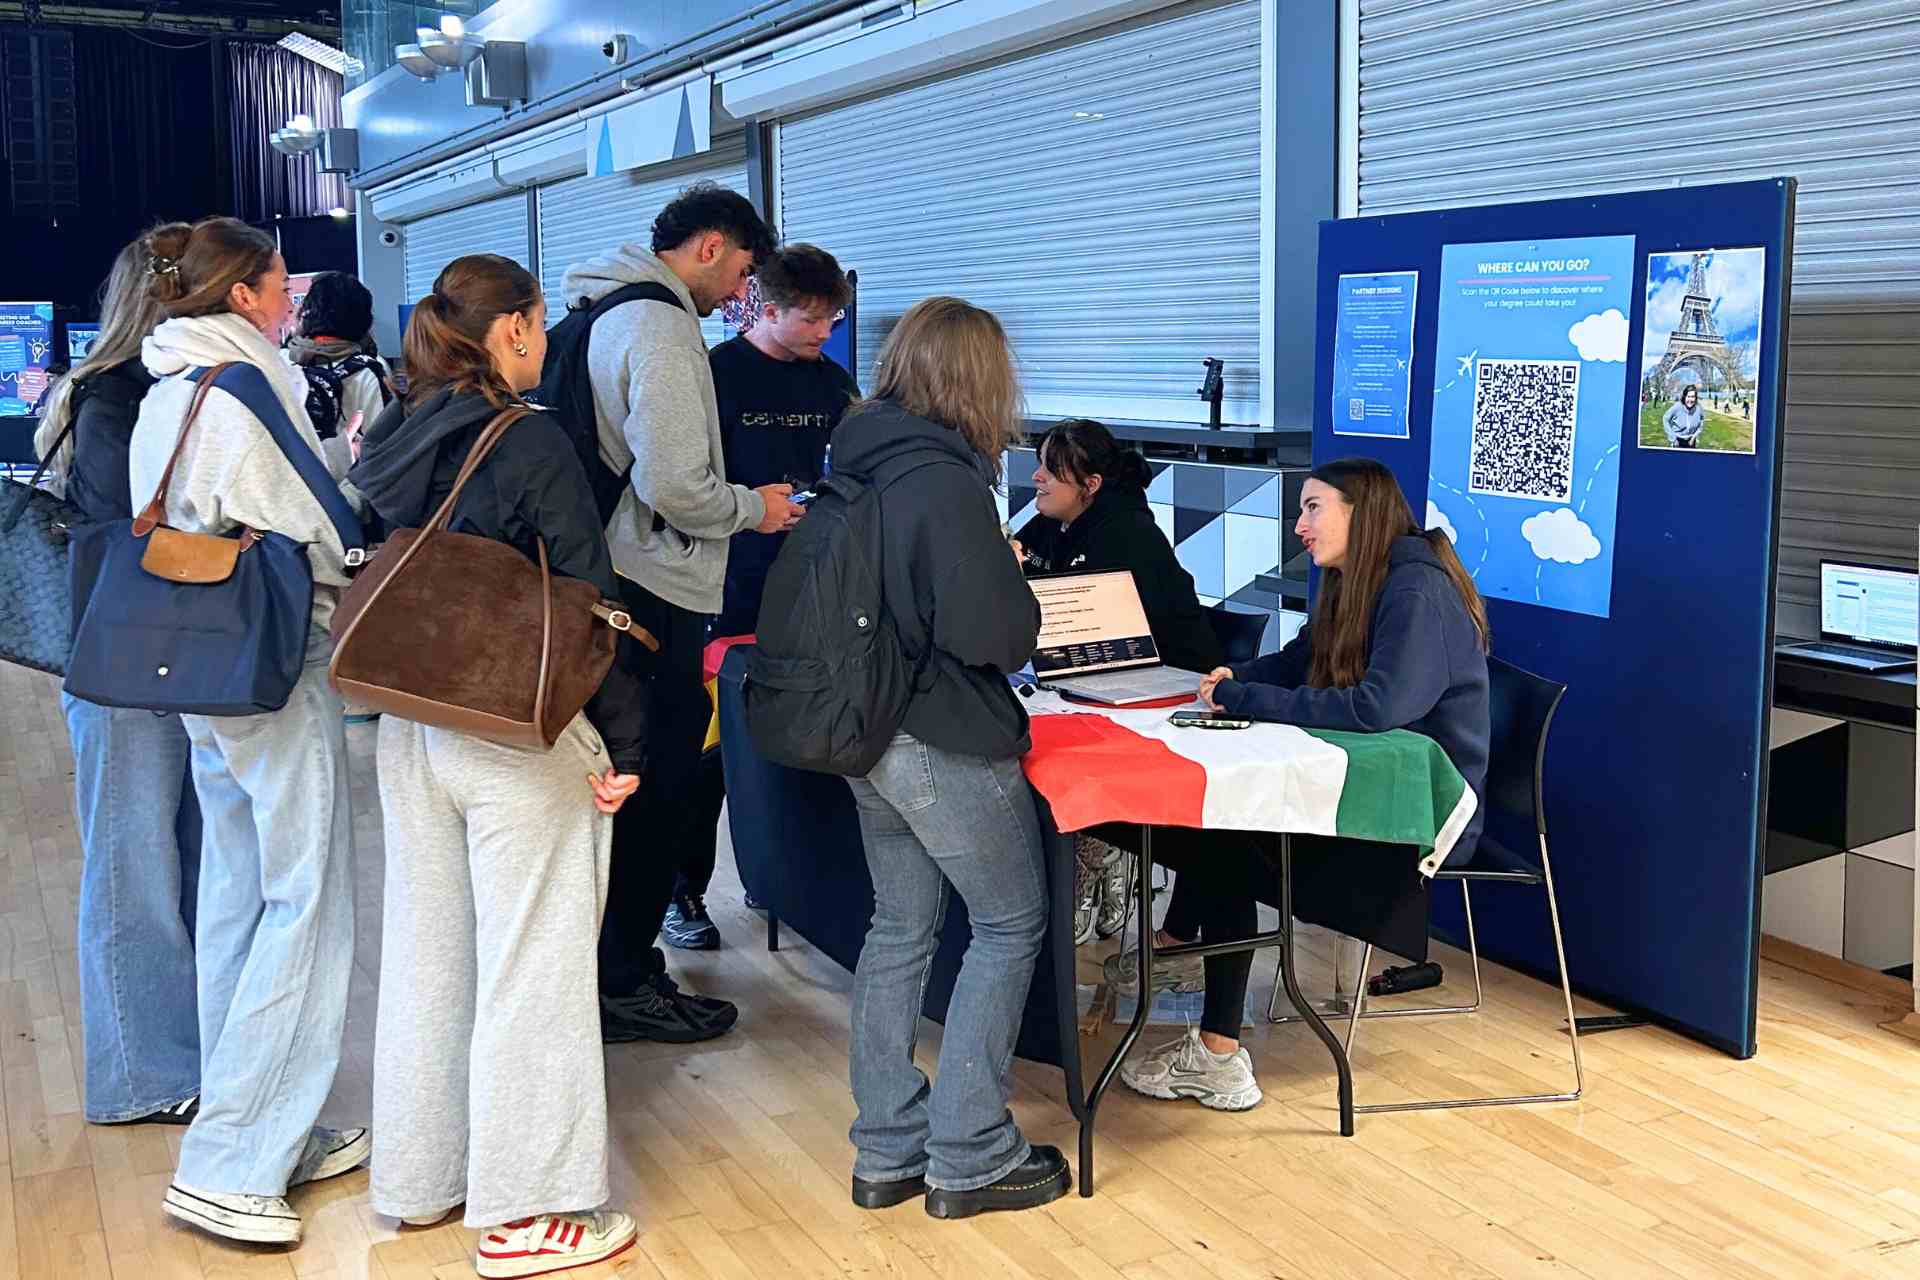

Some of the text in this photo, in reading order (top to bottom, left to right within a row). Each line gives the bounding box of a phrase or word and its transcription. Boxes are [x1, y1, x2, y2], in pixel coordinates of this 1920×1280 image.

[1478, 258, 1590, 274] WHERE CAN YOU GO?
[1462, 284, 1604, 297] Scan the QR Code below to discover where
[1484, 299, 1498, 310] your
[1500, 299, 1522, 310] degree
[1525, 298, 1543, 307] could
[1545, 297, 1560, 306] take
